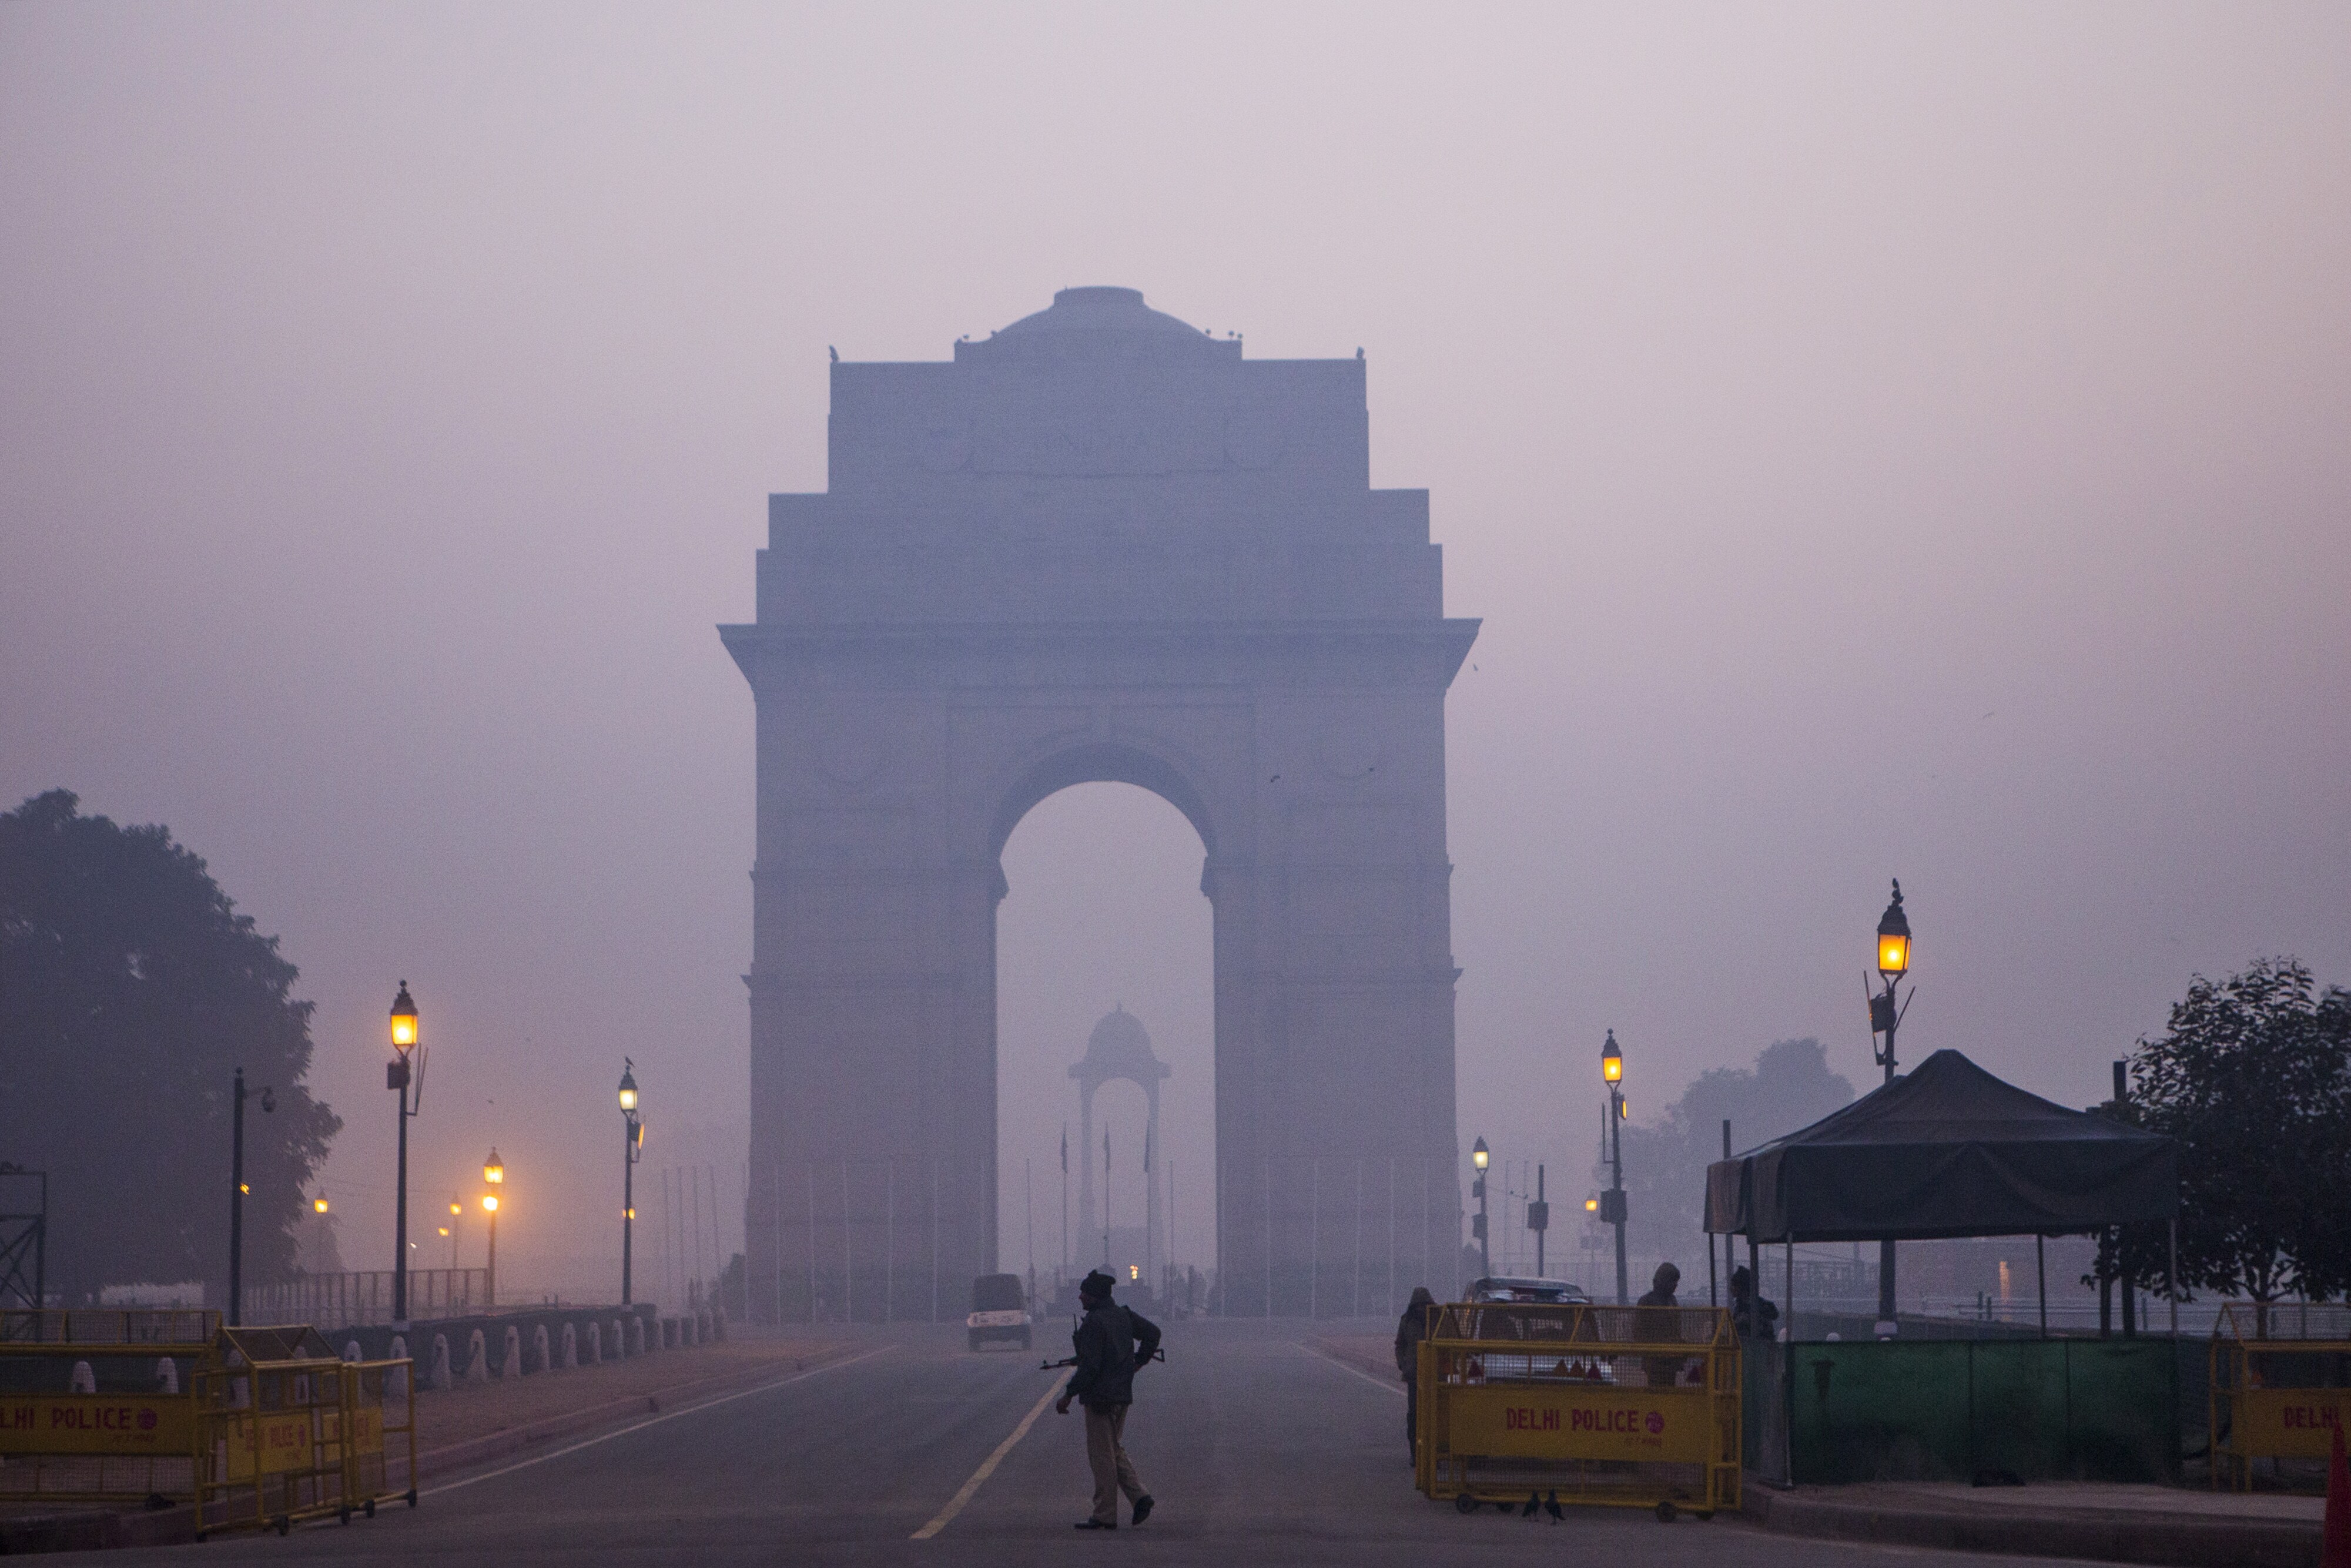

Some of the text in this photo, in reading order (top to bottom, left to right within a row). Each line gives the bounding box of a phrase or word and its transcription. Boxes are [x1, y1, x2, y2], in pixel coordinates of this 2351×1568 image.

[51, 1407, 131, 1430] POLICE
[1506, 1408, 1640, 1432] DELHI POLICE
